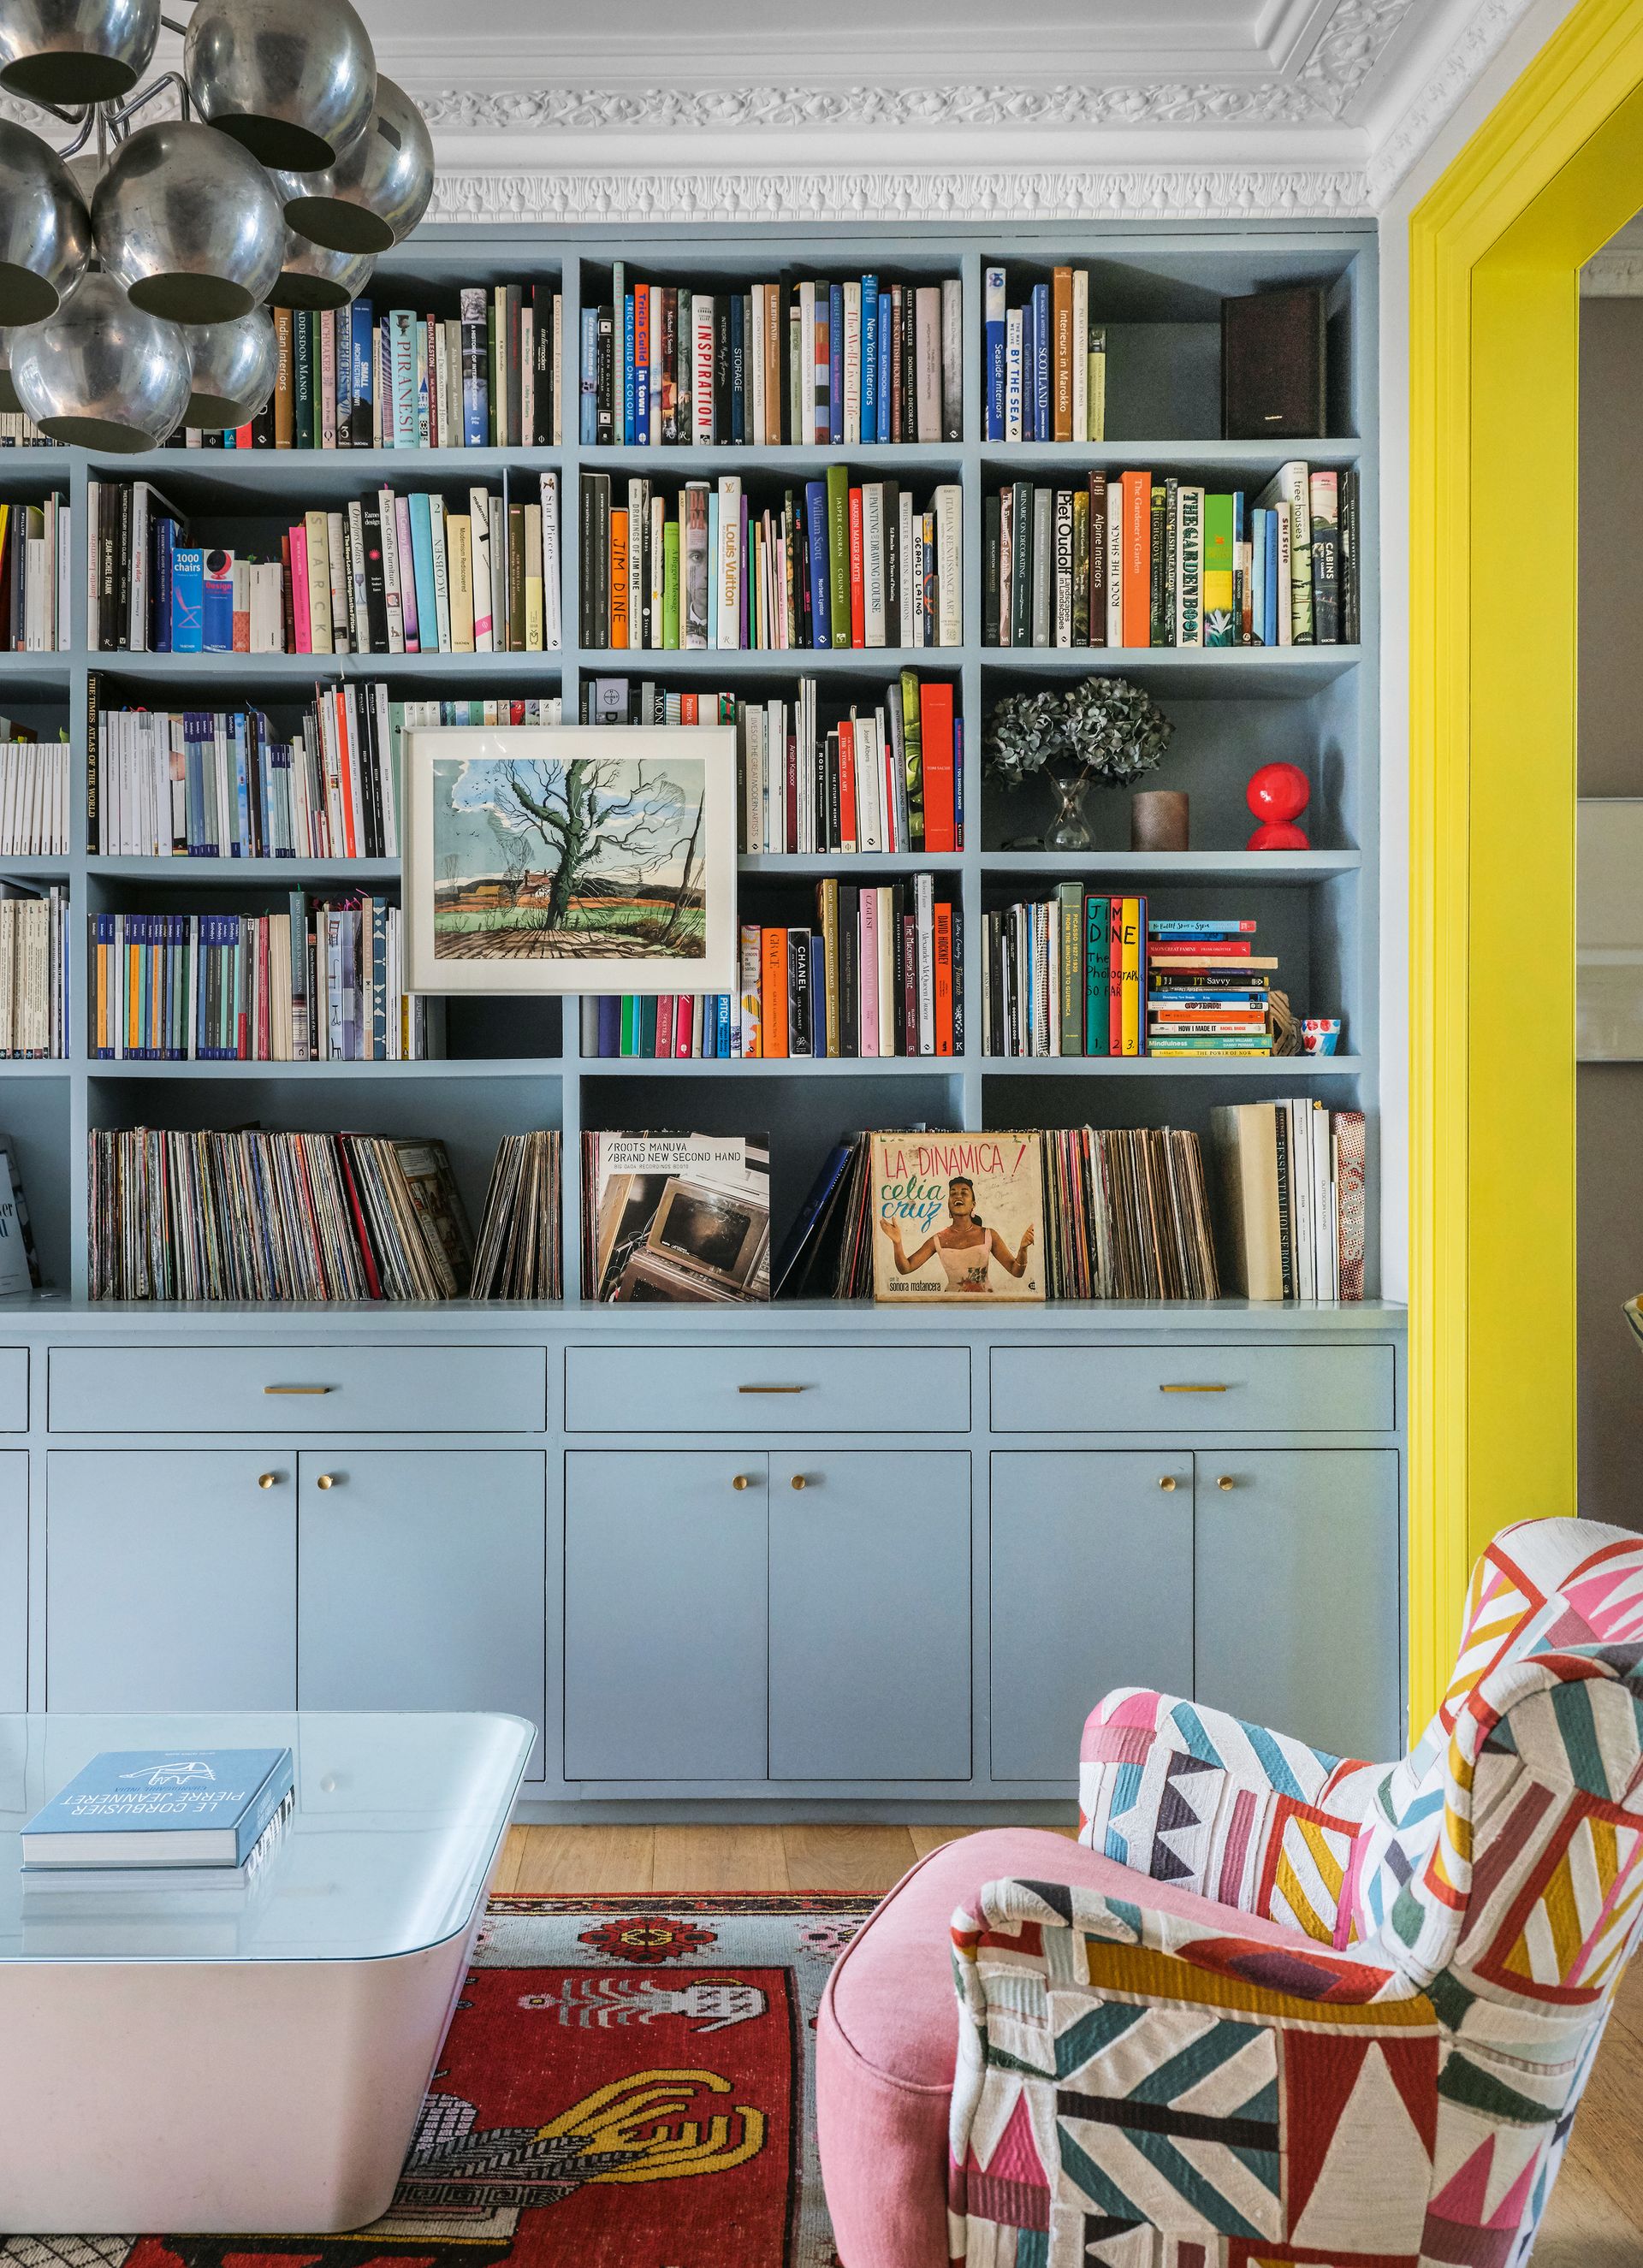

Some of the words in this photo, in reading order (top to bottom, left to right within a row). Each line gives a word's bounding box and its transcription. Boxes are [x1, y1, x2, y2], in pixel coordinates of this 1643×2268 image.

[279, 317, 288, 346] Indian
[866, 318, 875, 338] New
[1059, 311, 1068, 356] Interieurs
[638, 332, 647, 361] Guild
[866, 342, 875, 362] York
[1011, 349, 1019, 364] BY
[279, 350, 288, 391] Interiors
[627, 366, 633, 379] ON
[638, 370, 646, 381] in
[697, 325, 712, 427] INSPIRATION
[1059, 358, 1068, 367] in
[396, 341, 413, 433] PIRANESI
[866, 364, 875, 406] Interiors
[1011, 370, 1019, 394] THE
[1059, 370, 1068, 412] Marokko
[1011, 399, 1019, 423] SEA
[1294, 481, 1303, 500] tree
[472, 495, 489, 527] modernism
[813, 496, 823, 535] William
[1059, 494, 1071, 520] Piet
[1183, 492, 1198, 527] THE
[632, 503, 641, 542] DRAWINGS
[1093, 514, 1104, 545] Alpine
[1295, 504, 1306, 539] houses
[385, 528, 394, 550] Crafts
[632, 544, 641, 554] OF
[725, 524, 736, 560] Louis
[814, 536, 823, 560] Scott
[1058, 524, 1071, 575] Oudolf
[177, 554, 199, 562] 1000
[387, 552, 395, 587] Furniture
[632, 556, 641, 570] JIM
[1094, 547, 1103, 588] Interiors
[1183, 528, 1198, 595] GARDEN
[311, 517, 326, 632] STARCK
[632, 572, 641, 590] DINE
[725, 561, 736, 607] Vuitton
[1183, 596, 1198, 643] BOOK
[89, 755, 96, 766] OF
[938, 915, 948, 934] DAVID
[939, 936, 948, 965] HOCKNEY
[798, 946, 806, 991] CHANEL
[1207, 977, 1231, 986] Savvy
[649, 1143, 687, 1152] MANUVA
[649, 1153, 668, 1162] NEW
[673, 1153, 710, 1162] SECOND
[715, 1152, 740, 1161] HAND
[884, 1148, 908, 1178] LA
[881, 1175, 945, 1200] celia
[881, 1200, 942, 1233] cruz
[1343, 1156, 1362, 1260] KOONS
[890, 1281, 909, 1292] sonora
[910, 1281, 940, 1292] matancera
[61, 1791, 173, 1805] JEANNERET
[71, 1803, 187, 1815] CORBUSIER
[176, 1791, 246, 1802] PIERRE
[196, 1803, 217, 1815] LE
